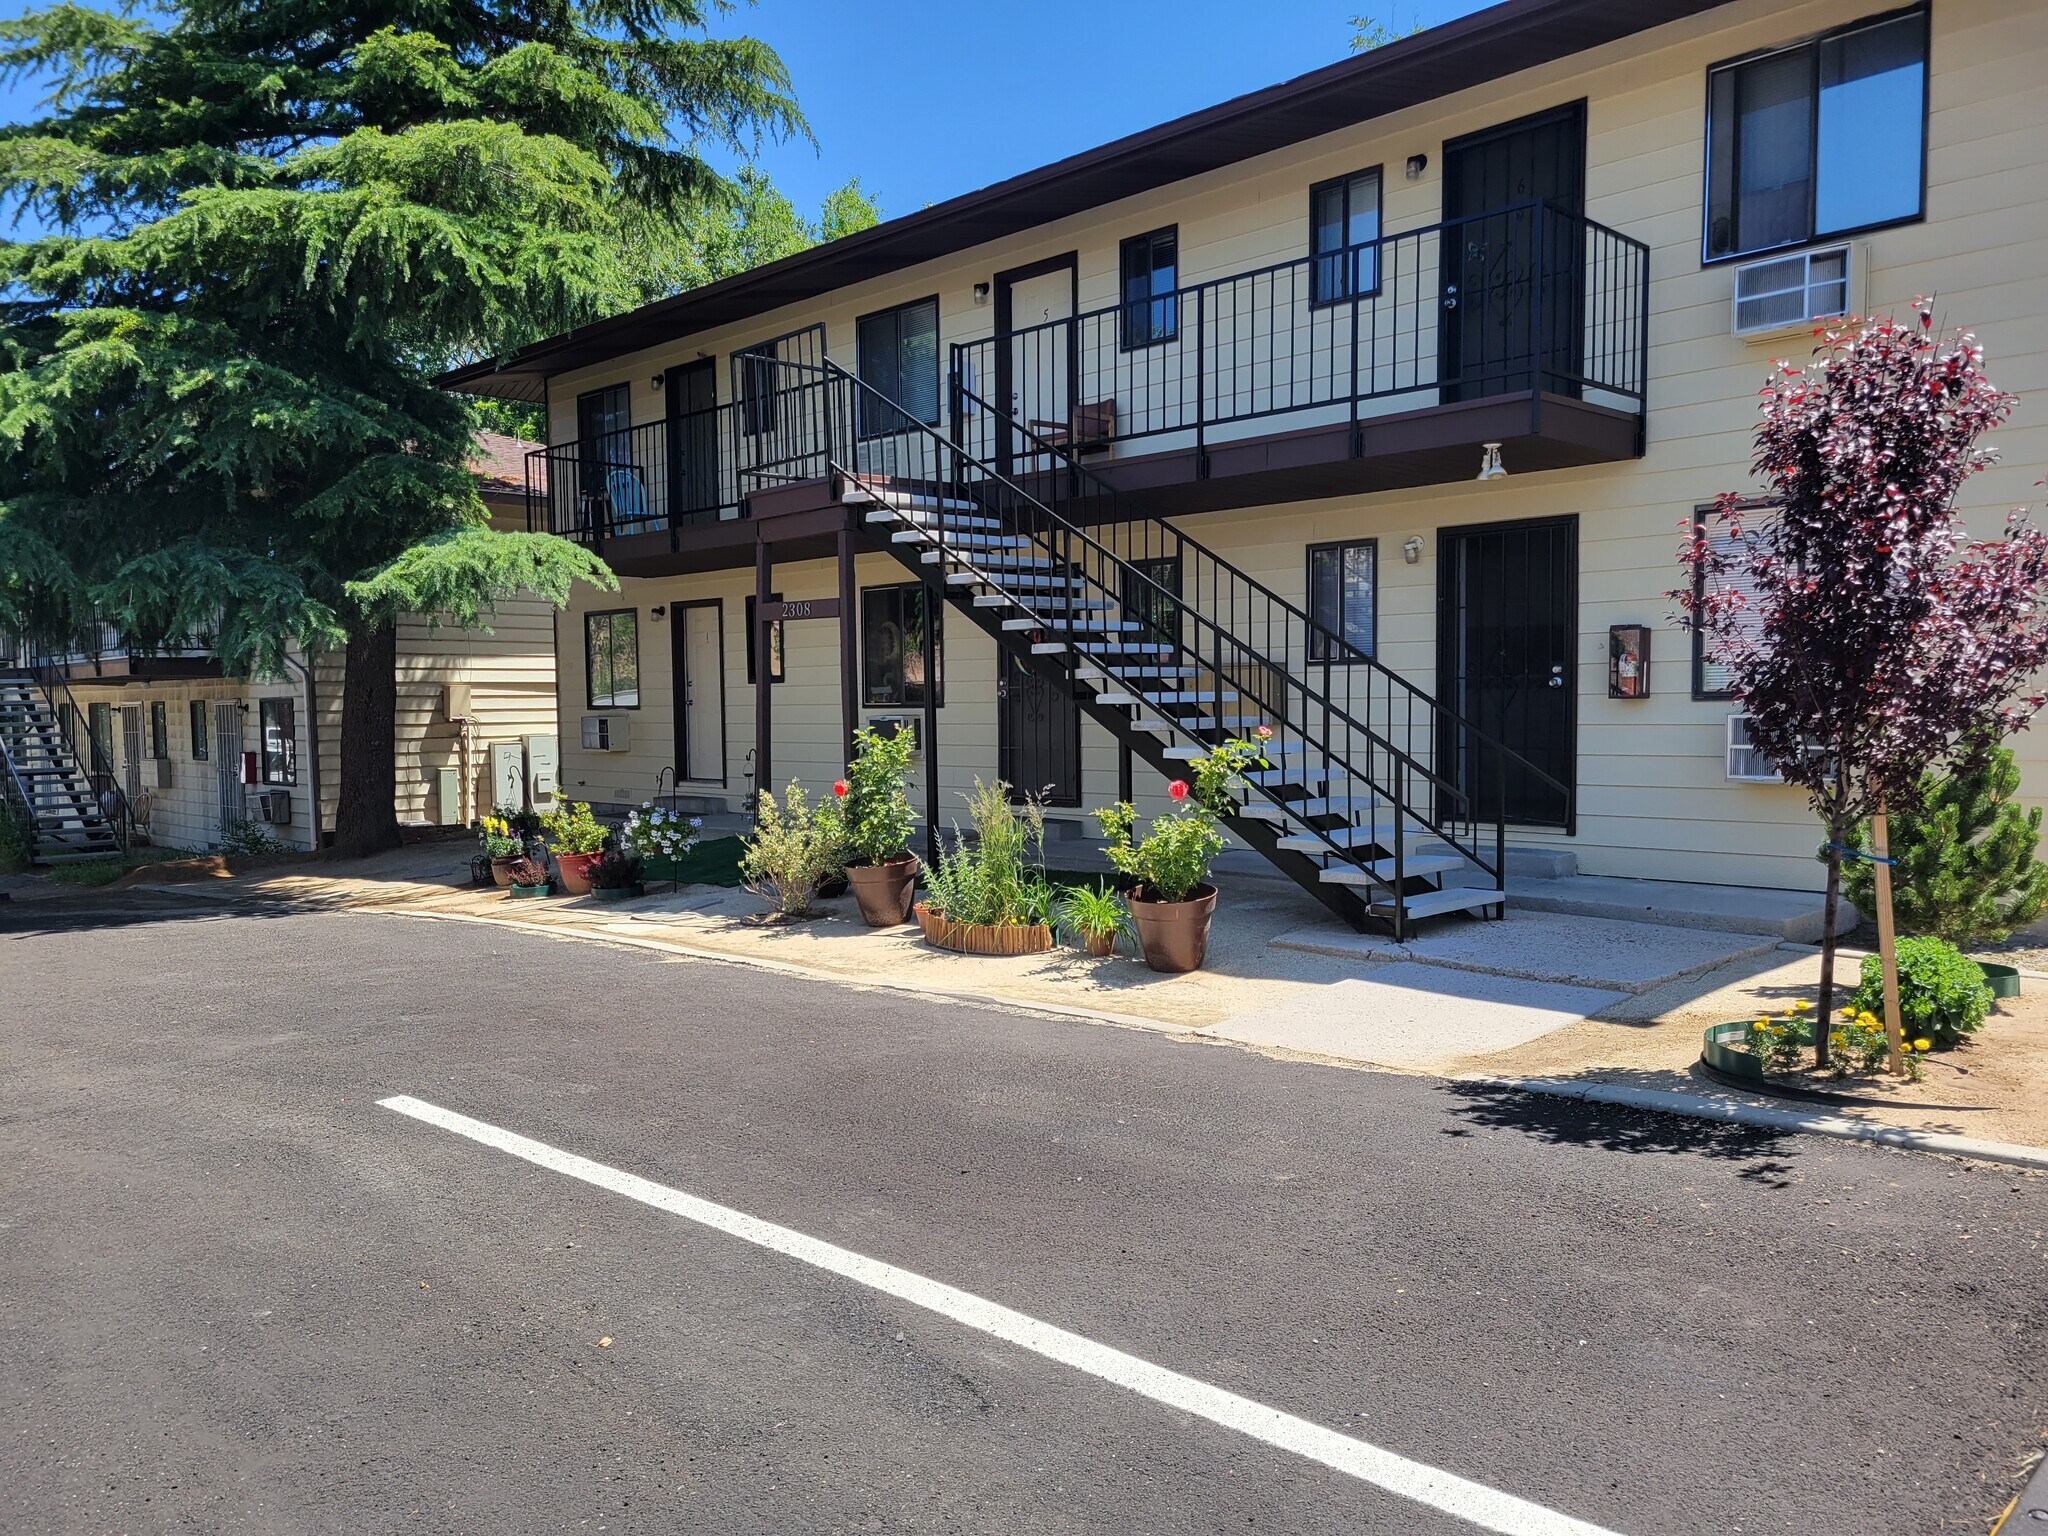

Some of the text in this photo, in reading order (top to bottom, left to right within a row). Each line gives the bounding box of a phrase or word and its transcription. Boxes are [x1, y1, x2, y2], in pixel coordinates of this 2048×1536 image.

[1517, 177, 1525, 194] 6
[1043, 308, 1049, 323] 5
[782, 602, 811, 617] 2308
